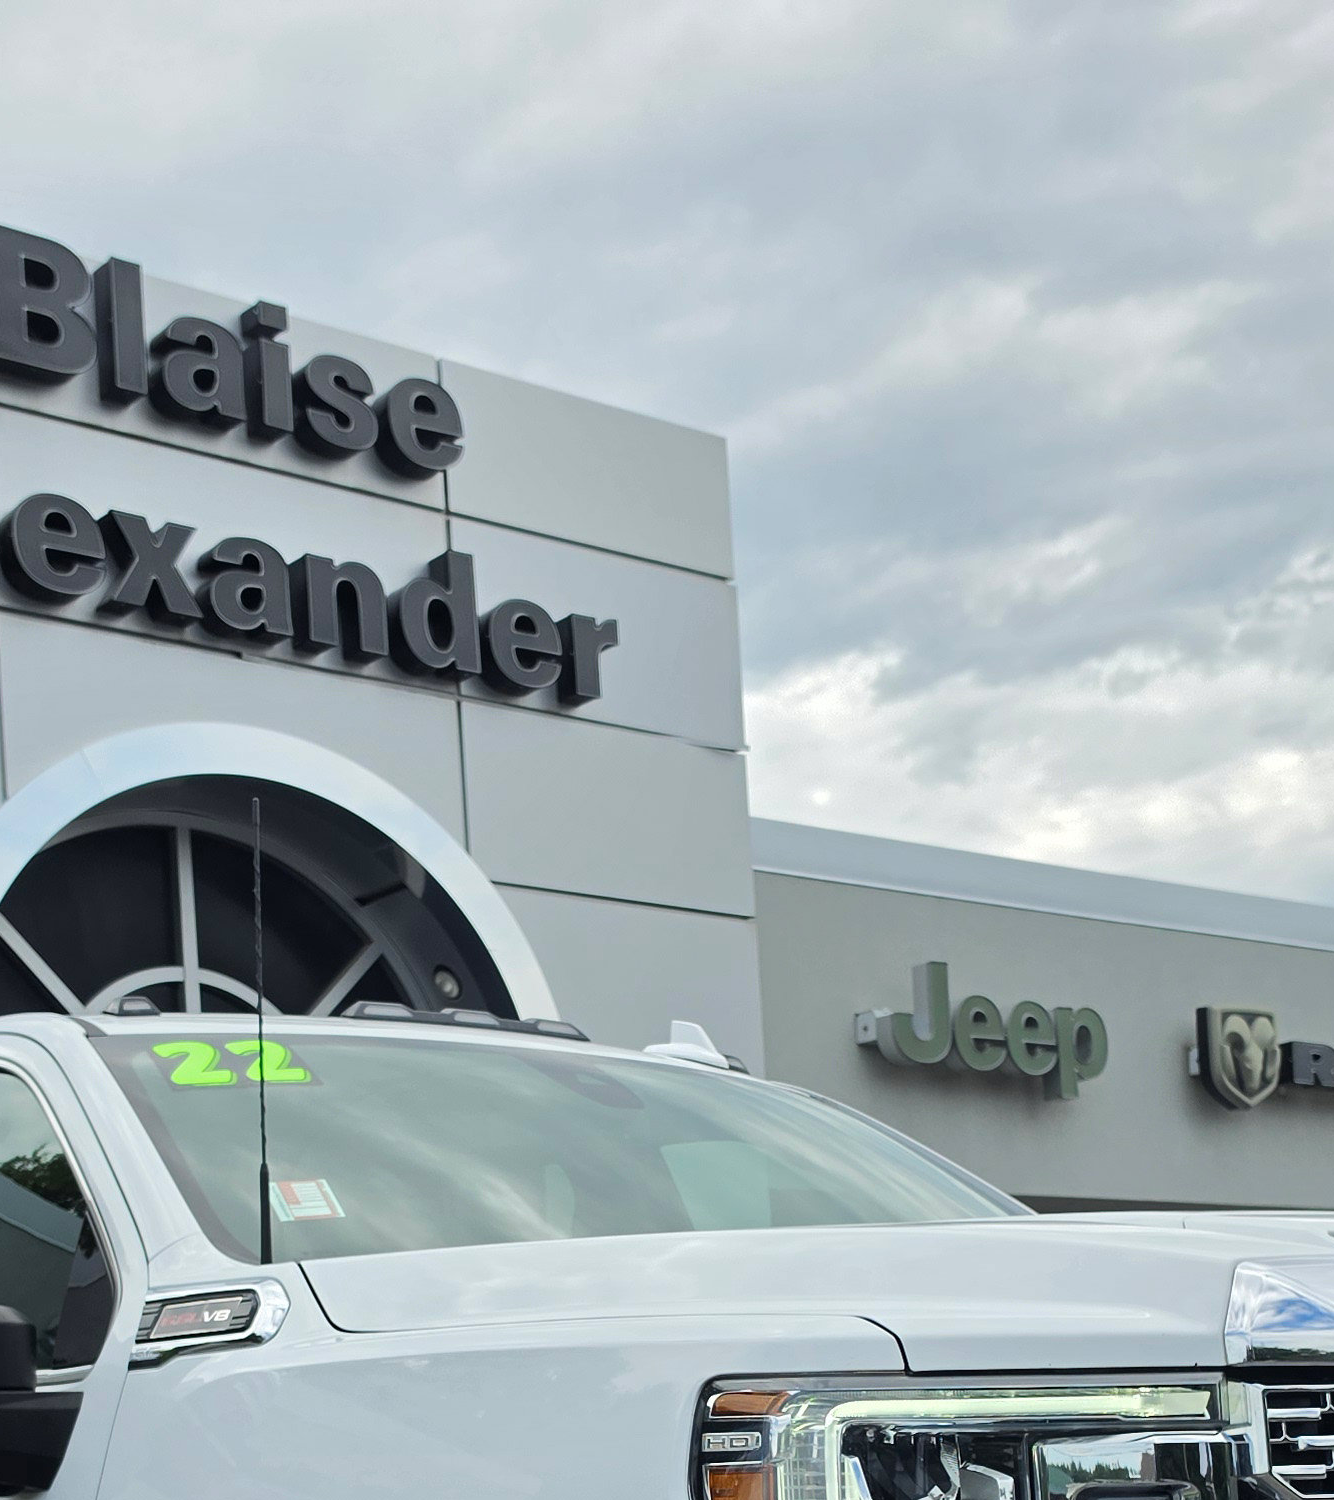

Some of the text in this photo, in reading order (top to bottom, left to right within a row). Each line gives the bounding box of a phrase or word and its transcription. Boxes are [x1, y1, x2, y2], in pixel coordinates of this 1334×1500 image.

[876, 961, 1109, 1100] Jeep
[152, 1040, 312, 1086] 22
[203, 1309, 231, 1322] V8
